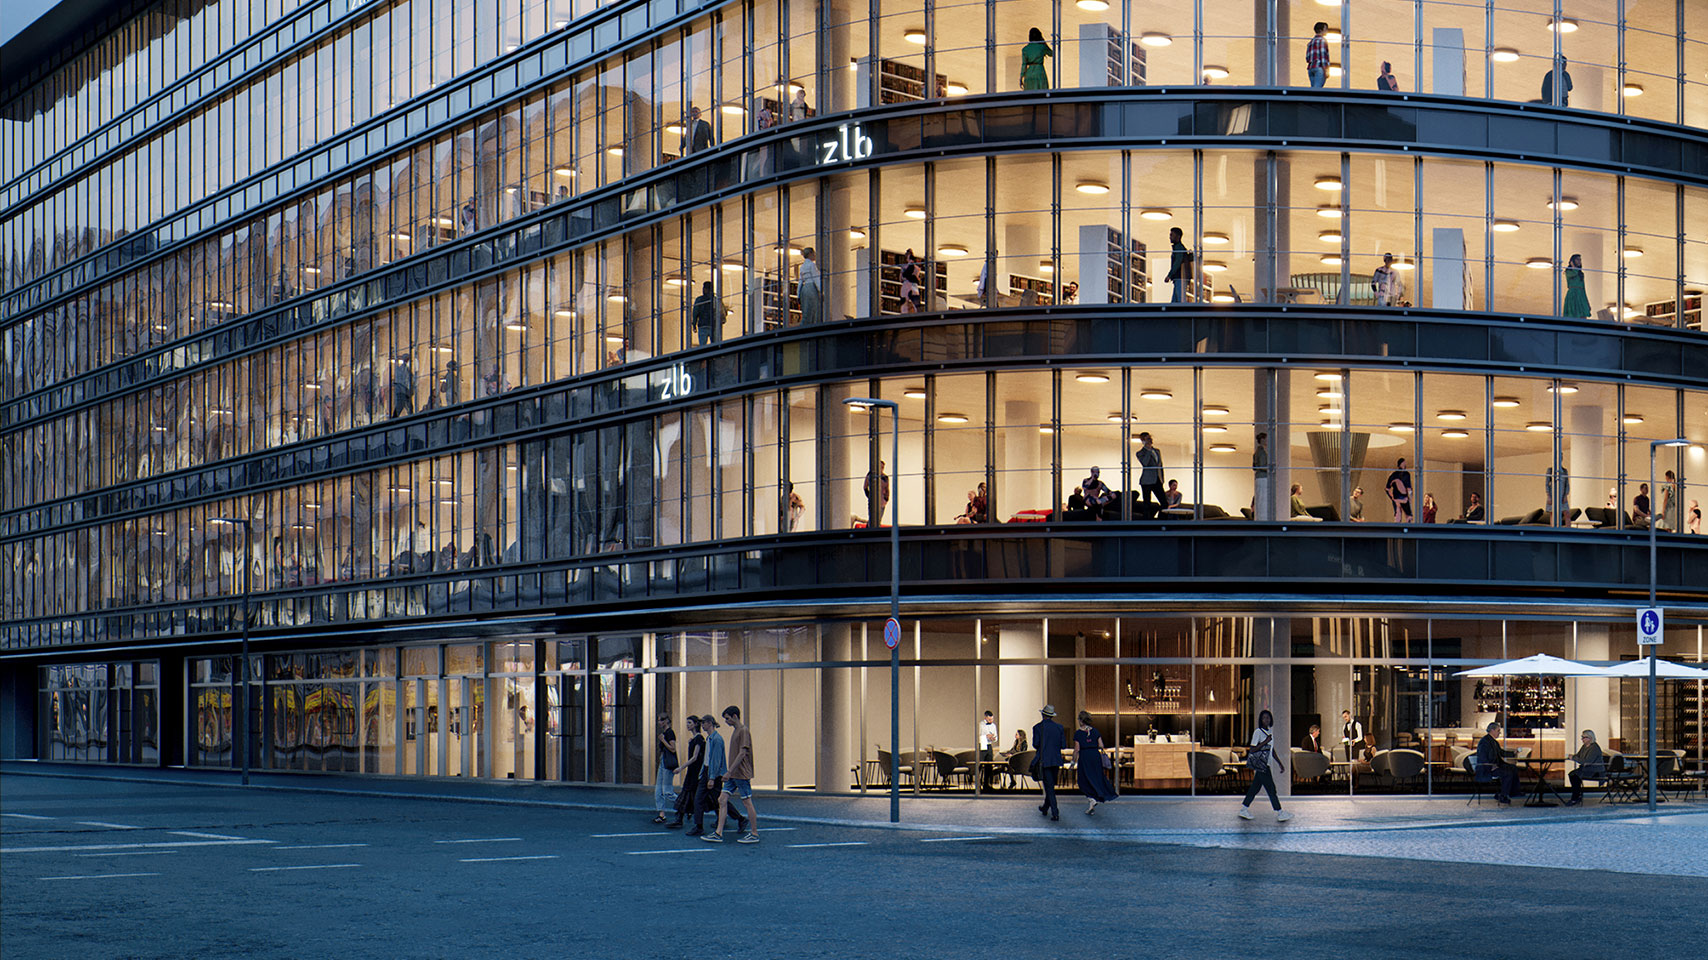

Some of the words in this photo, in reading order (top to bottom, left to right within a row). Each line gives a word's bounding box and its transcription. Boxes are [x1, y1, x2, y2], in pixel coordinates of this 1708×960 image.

[823, 121, 873, 164] zlb
[661, 362, 692, 400] zlb
[1642, 635, 1657, 644] ZONE
